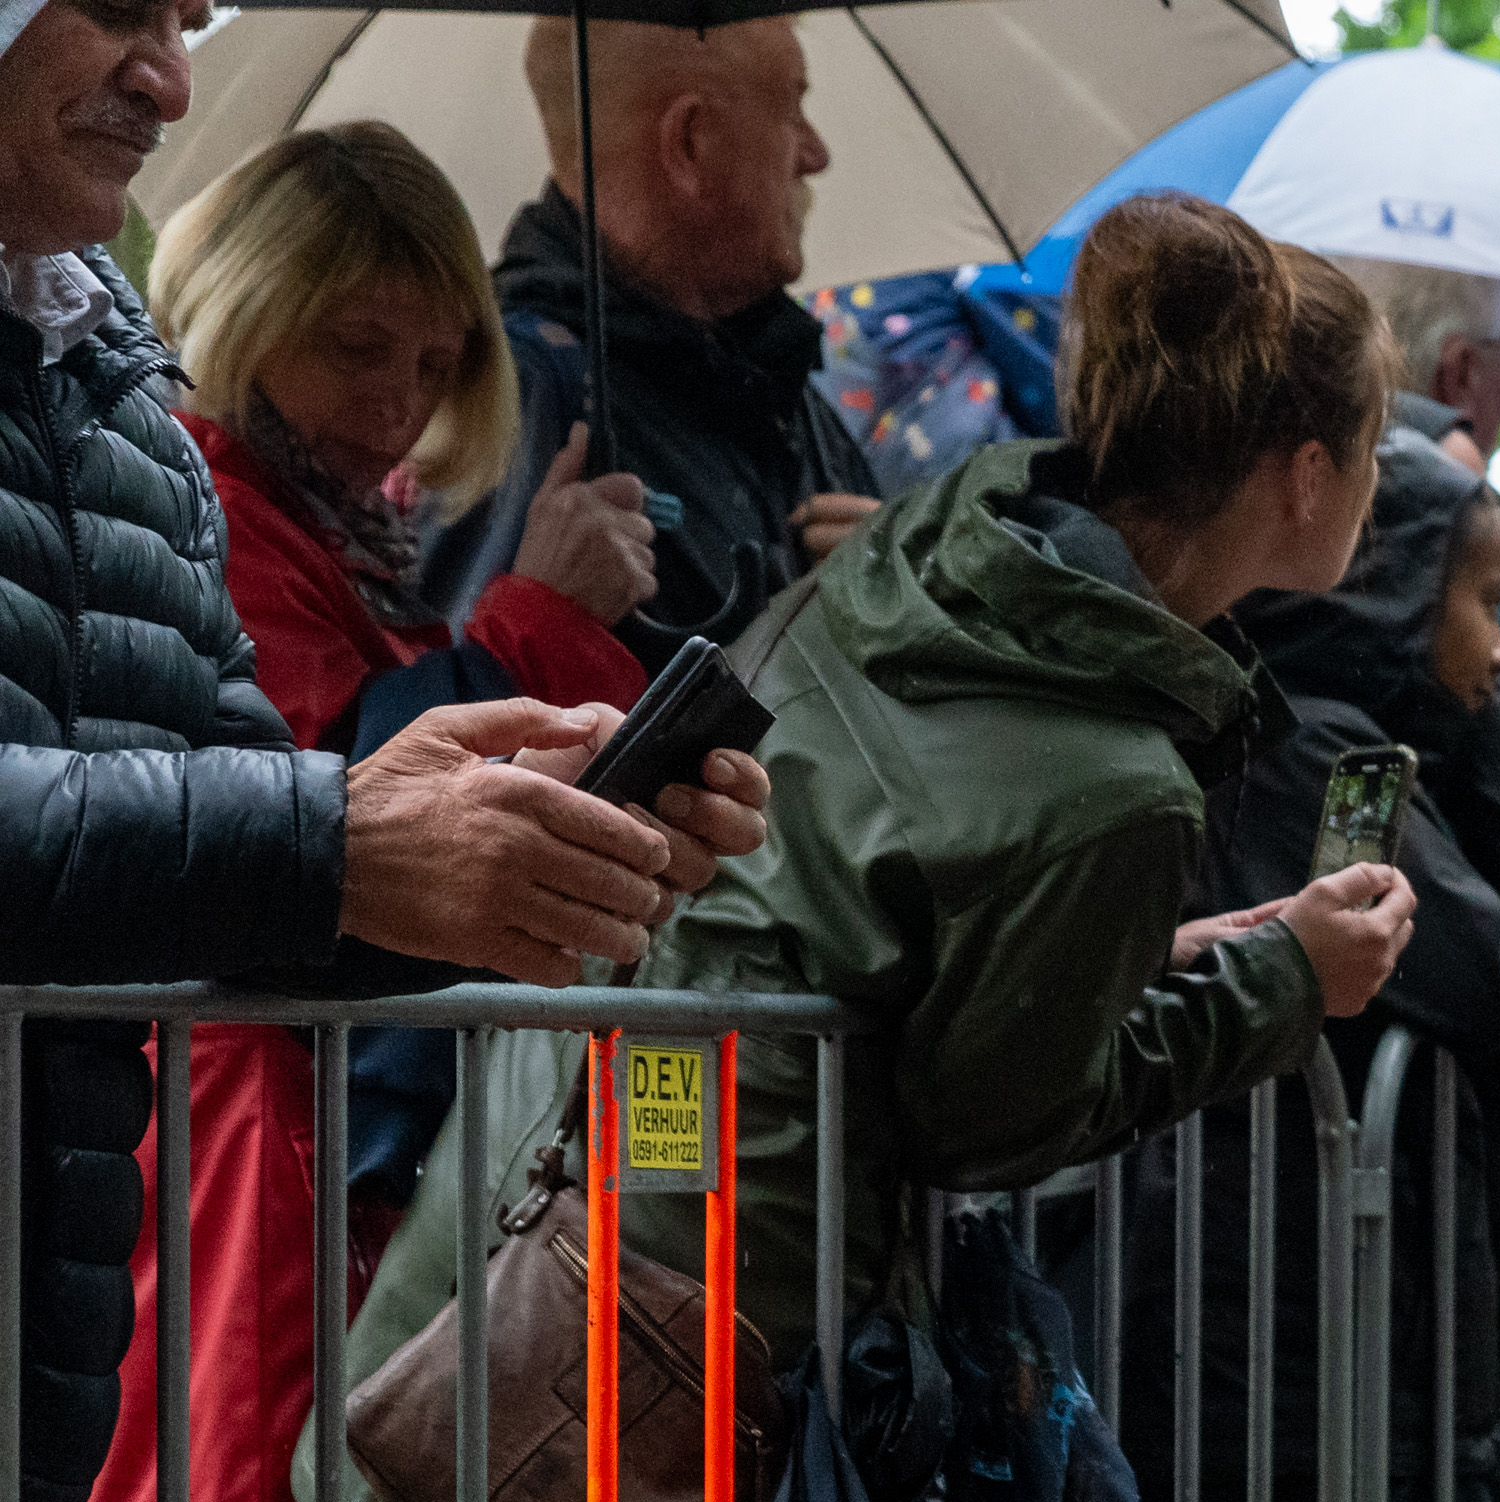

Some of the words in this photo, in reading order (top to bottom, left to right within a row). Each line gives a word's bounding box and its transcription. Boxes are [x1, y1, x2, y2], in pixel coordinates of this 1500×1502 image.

[633, 1055, 698, 1102] D.E.V.
[633, 1106, 698, 1135] VERHUUR
[632, 1139, 699, 1163] 0591-611222
